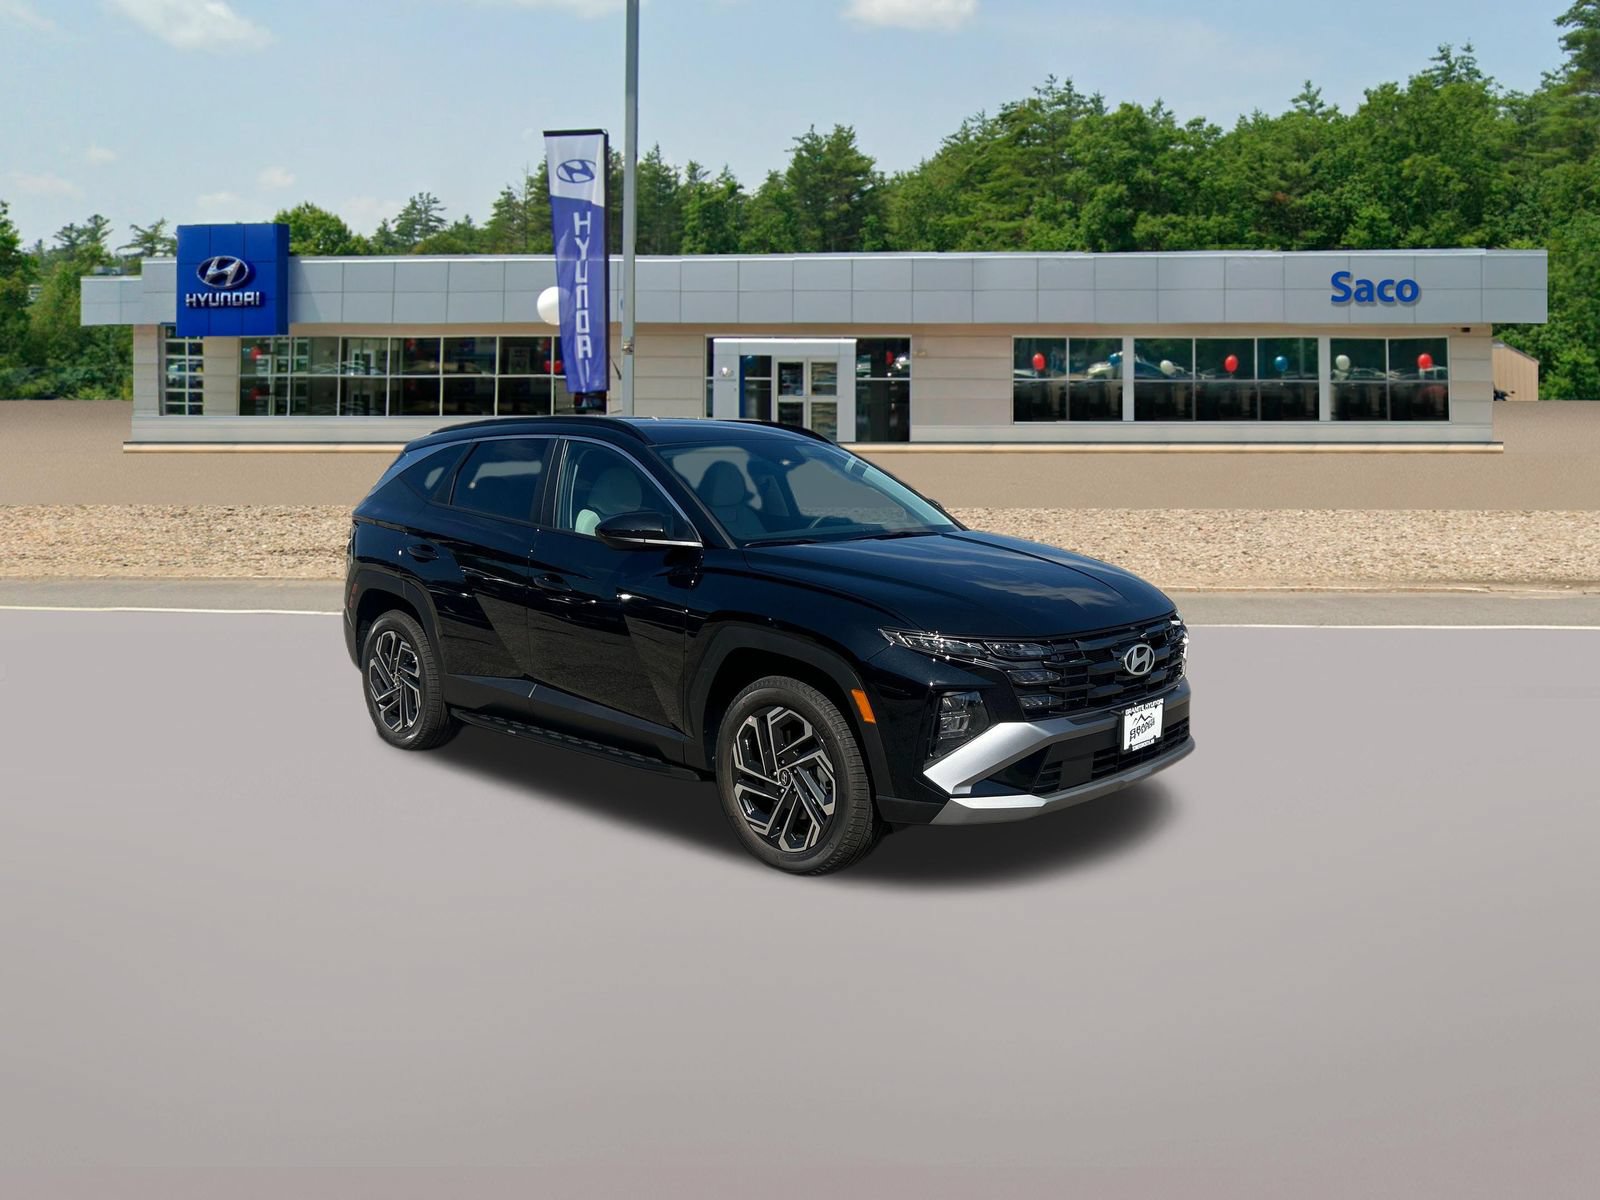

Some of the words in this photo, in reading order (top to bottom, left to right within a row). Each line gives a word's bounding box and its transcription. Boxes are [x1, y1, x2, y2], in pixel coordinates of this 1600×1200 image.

[185, 291, 260, 308] HYUNDAI
[573, 211, 593, 384] HYUNDAI
[1330, 270, 1420, 303] Saco
